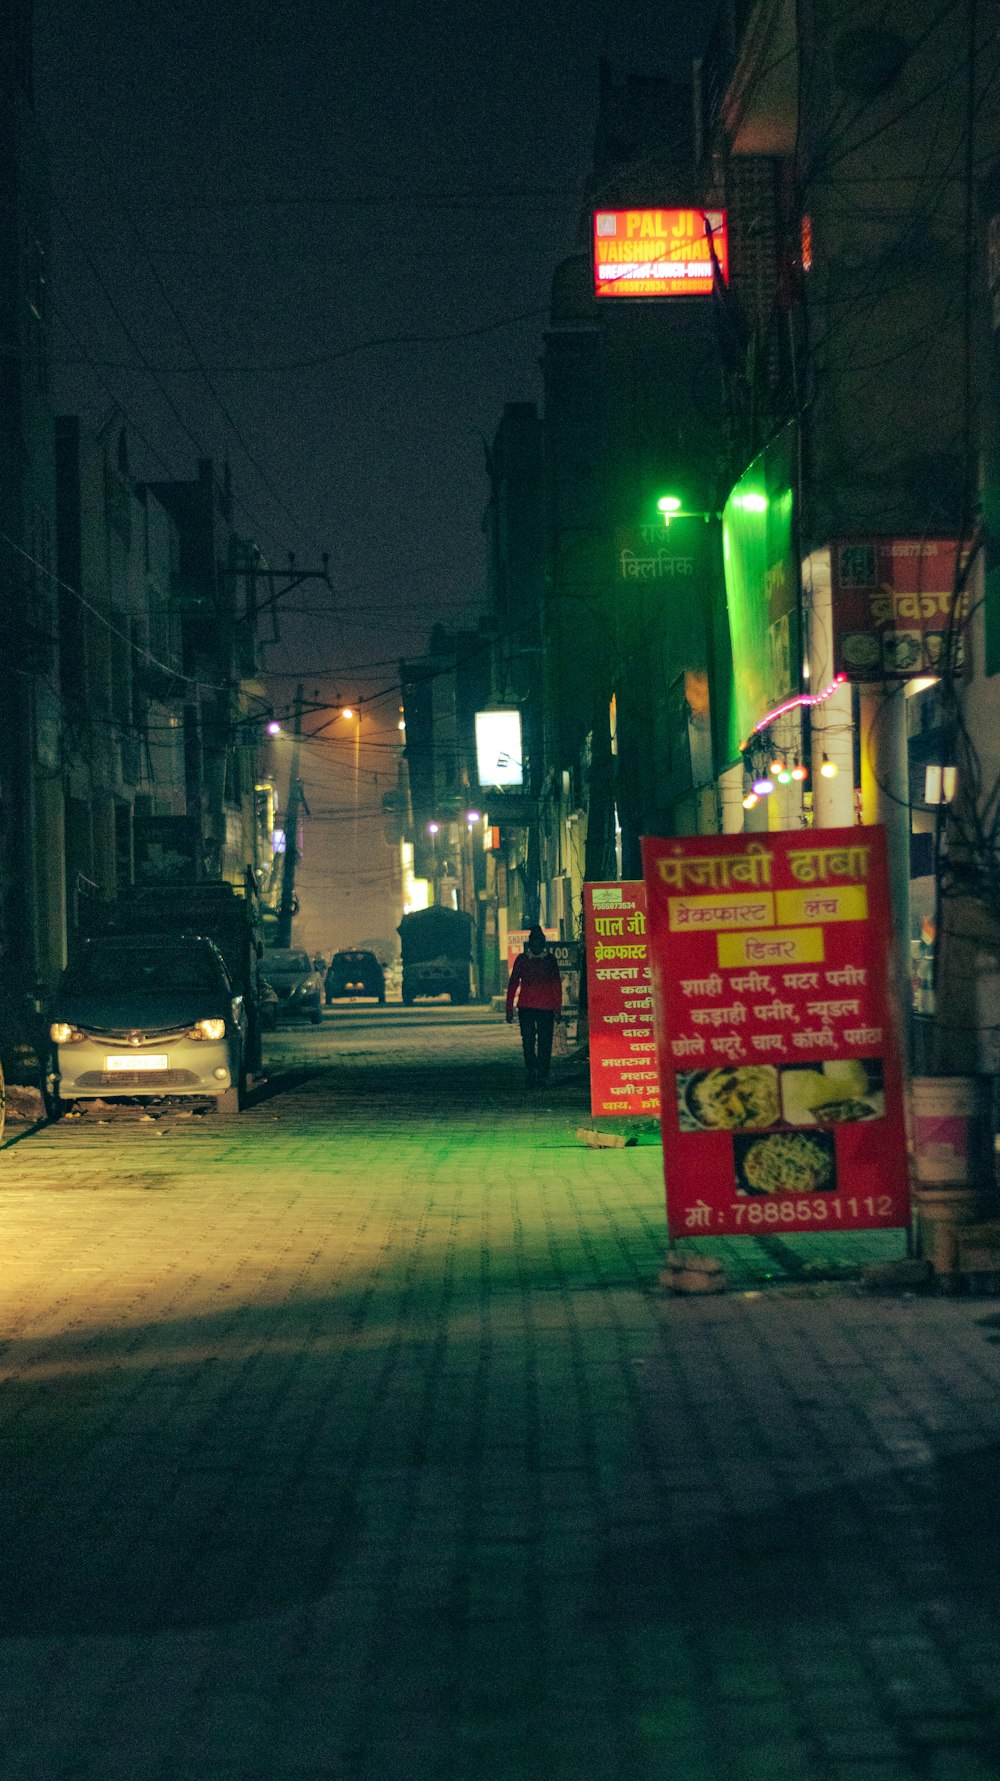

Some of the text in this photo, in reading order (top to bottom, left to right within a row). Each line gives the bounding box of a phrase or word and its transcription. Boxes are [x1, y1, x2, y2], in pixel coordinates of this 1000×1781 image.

[626, 211, 694, 238] PAL JI
[597, 240, 666, 262] VAISHNO
[656, 842, 870, 888] पंजाबी ढाबा
[594, 911, 646, 936] पाल जी
[594, 940, 647, 963] ब्रेकफास्ट
[744, 937, 796, 959] डिनर
[595, 967, 639, 981] सस्ता
[680, 973, 723, 998] शाही
[782, 973, 819, 989] मटर
[824, 964, 867, 987] पनीर
[603, 1012, 637, 1023] पनीर
[622, 1029, 651, 1037] दाल
[610, 1084, 645, 1095] पनीर
[731, 1196, 892, 1226] 7888531112
